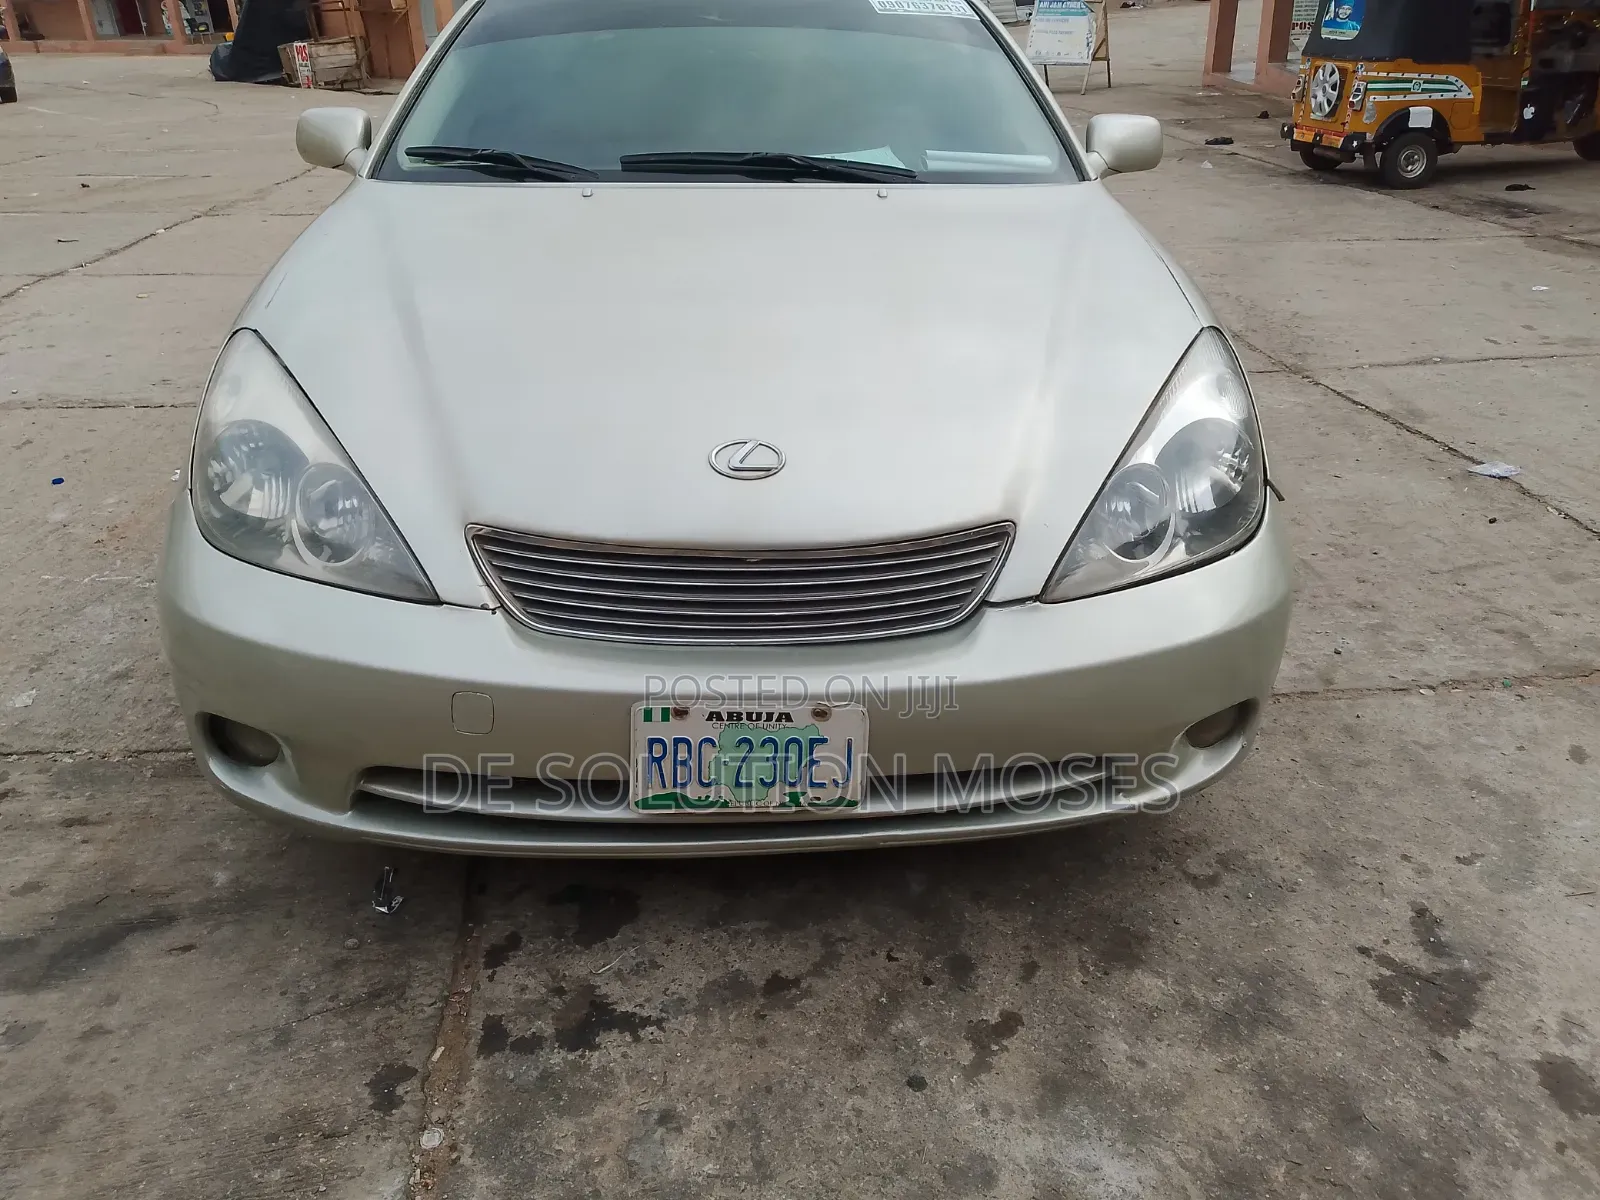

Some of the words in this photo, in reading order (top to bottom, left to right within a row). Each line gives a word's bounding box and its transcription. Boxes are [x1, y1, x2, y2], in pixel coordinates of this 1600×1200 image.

[1291, 21, 1314, 31] POS
[295, 44, 309, 62] POS
[705, 710, 794, 723] ABUJA
[711, 722, 746, 730] CENTRE
[747, 722, 760, 730] OF
[762, 722, 787, 730] UNITY
